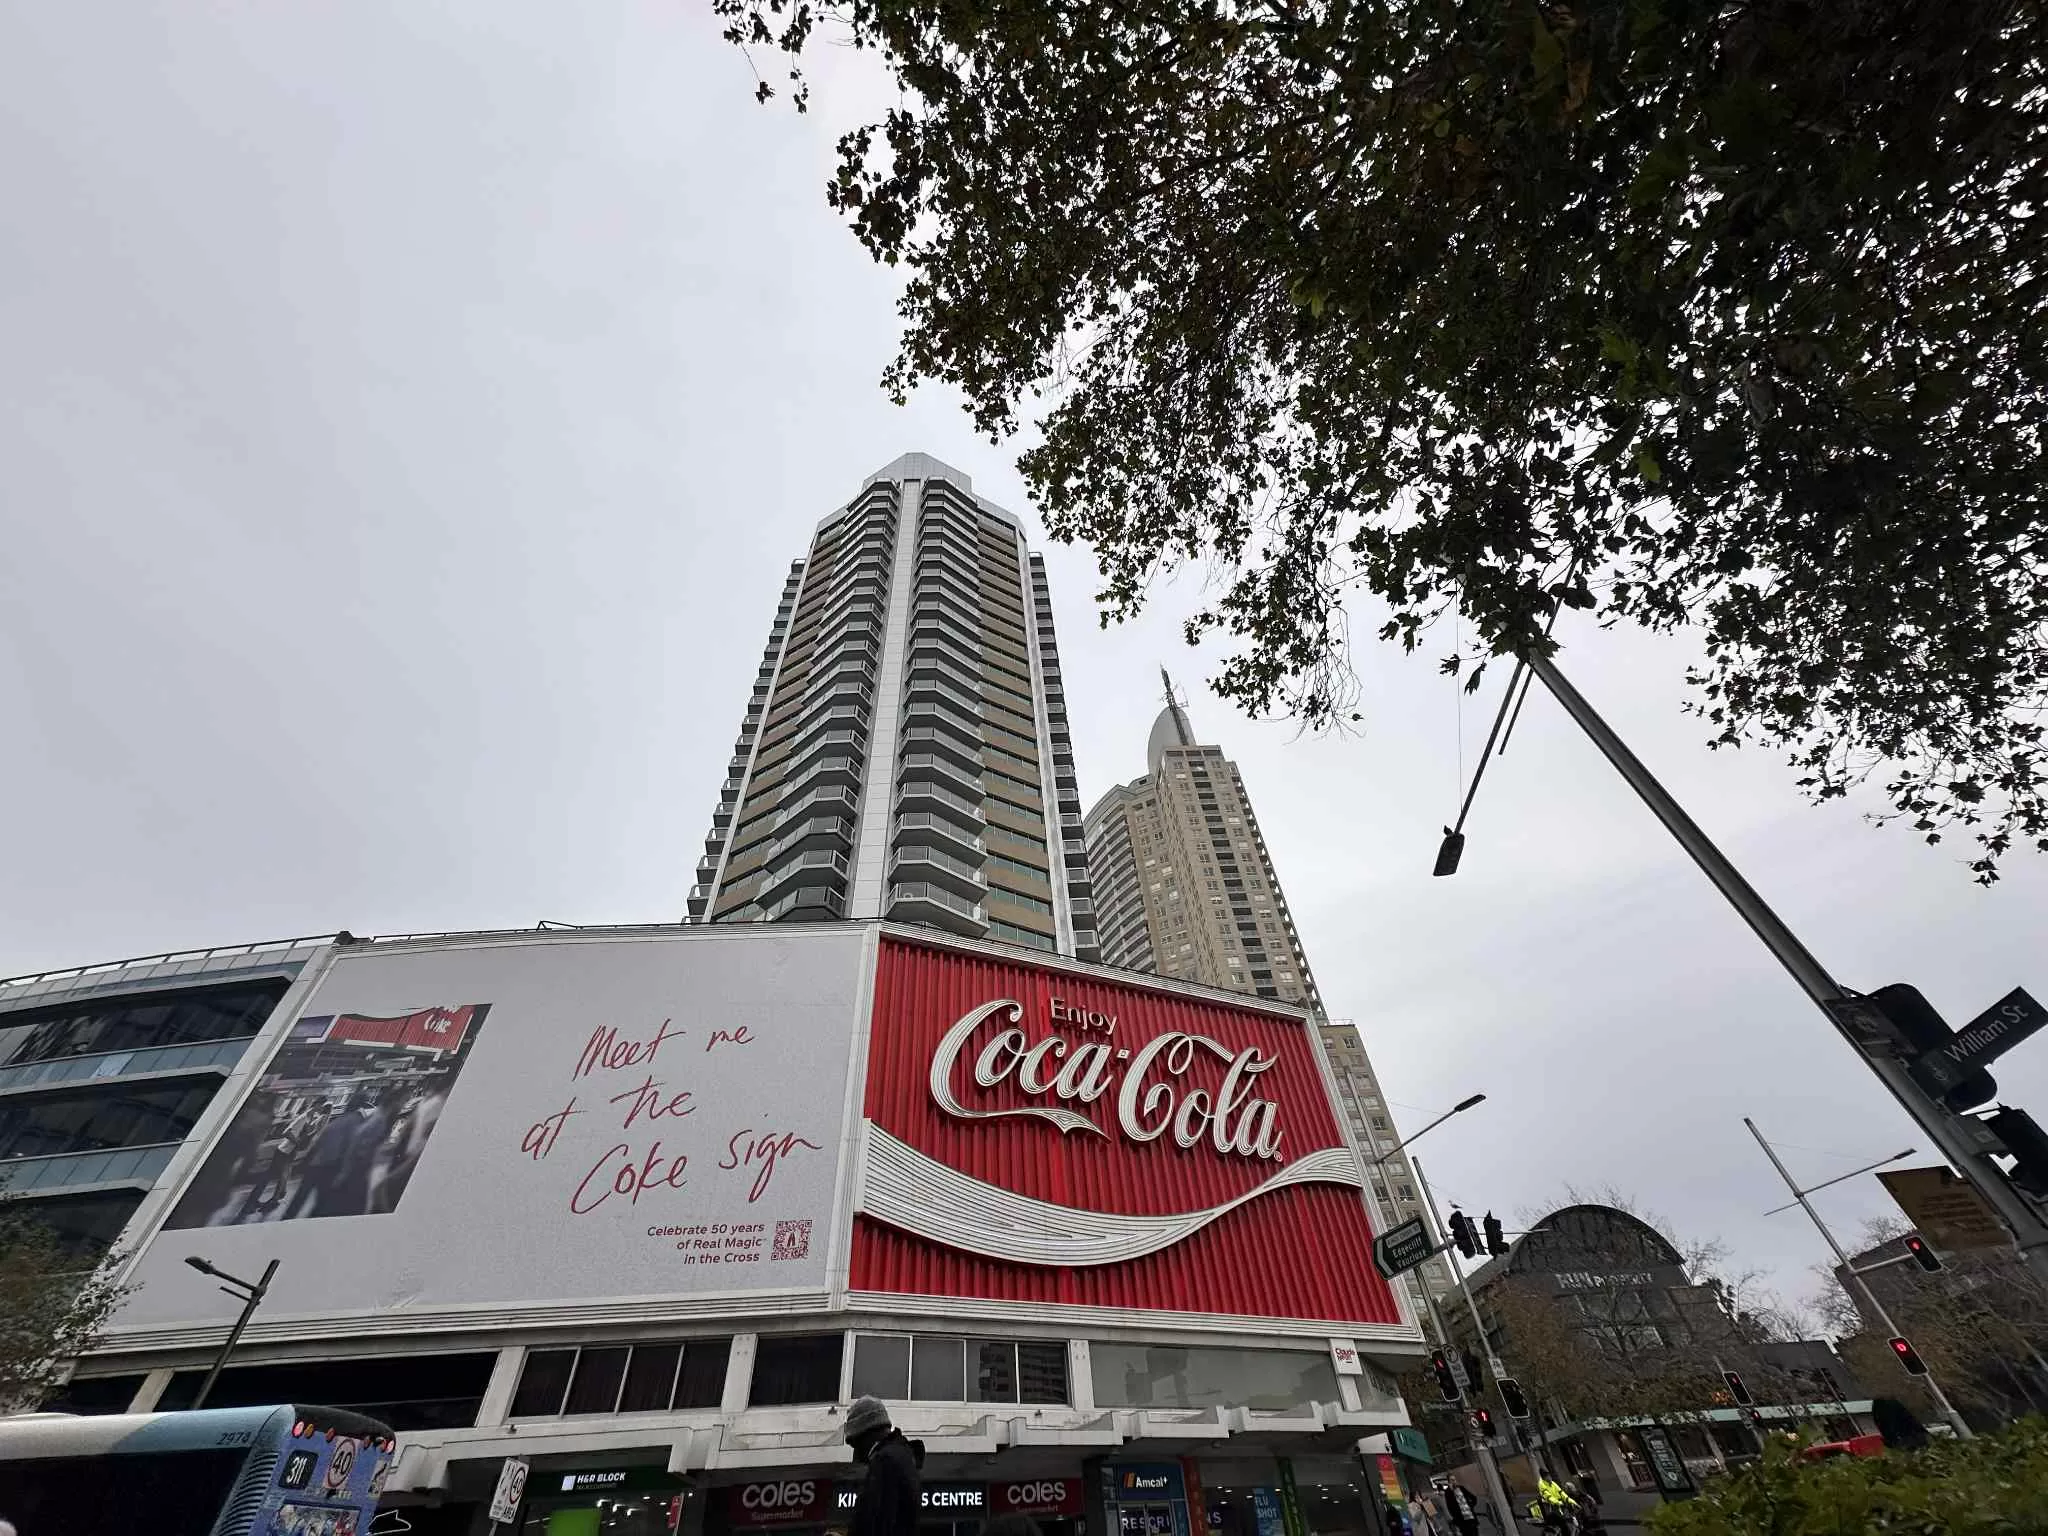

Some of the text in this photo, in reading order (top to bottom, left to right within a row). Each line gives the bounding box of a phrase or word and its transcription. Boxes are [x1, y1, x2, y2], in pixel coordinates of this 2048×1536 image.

[1050, 997, 1118, 1036] Enjoy
[1944, 1004, 2029, 1063] William St
[572, 1018, 755, 1081] Meet me
[521, 1097, 588, 1160] at
[571, 1113, 823, 1214] Coke sign
[647, 1223, 765, 1237] Celebrate 50 years
[677, 1236, 763, 1250] of Real Magic
[684, 1252, 760, 1265] in the Cross
[286, 1456, 308, 1485] 311
[332, 1451, 352, 1474] 40
[597, 1472, 626, 1483] BLOCK
[742, 1481, 816, 1509] coles
[932, 1492, 983, 1507] CENTRE
[1007, 1481, 1067, 1505] coles
